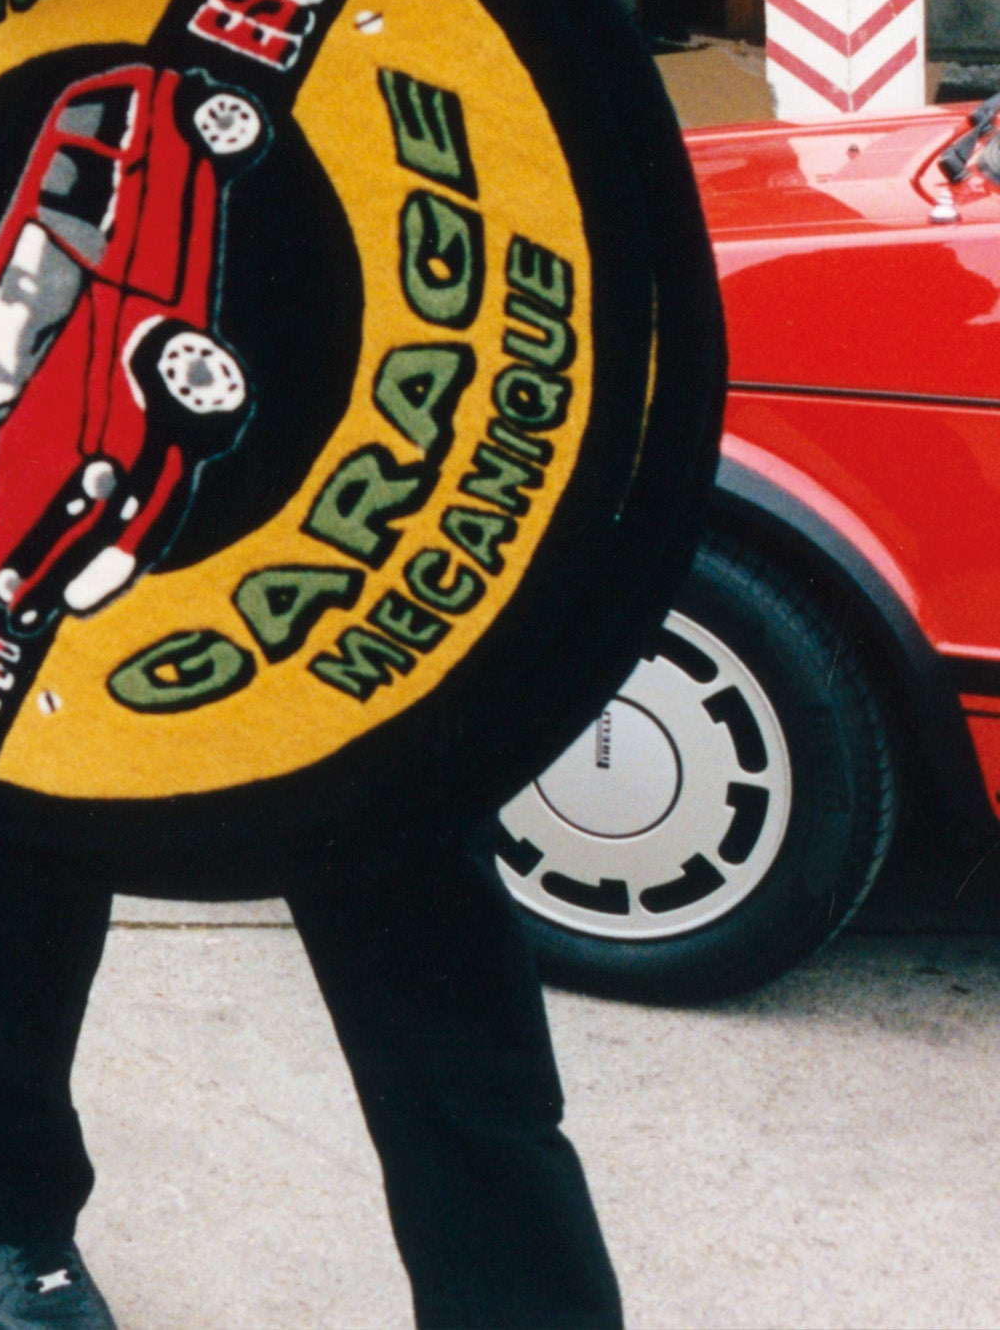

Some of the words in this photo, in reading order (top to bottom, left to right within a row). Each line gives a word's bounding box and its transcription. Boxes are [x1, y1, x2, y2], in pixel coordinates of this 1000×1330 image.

[106, 64, 485, 714] GARAGE
[308, 235, 576, 702] MECANIQUE
[595, 711, 611, 769] PIRELLI
